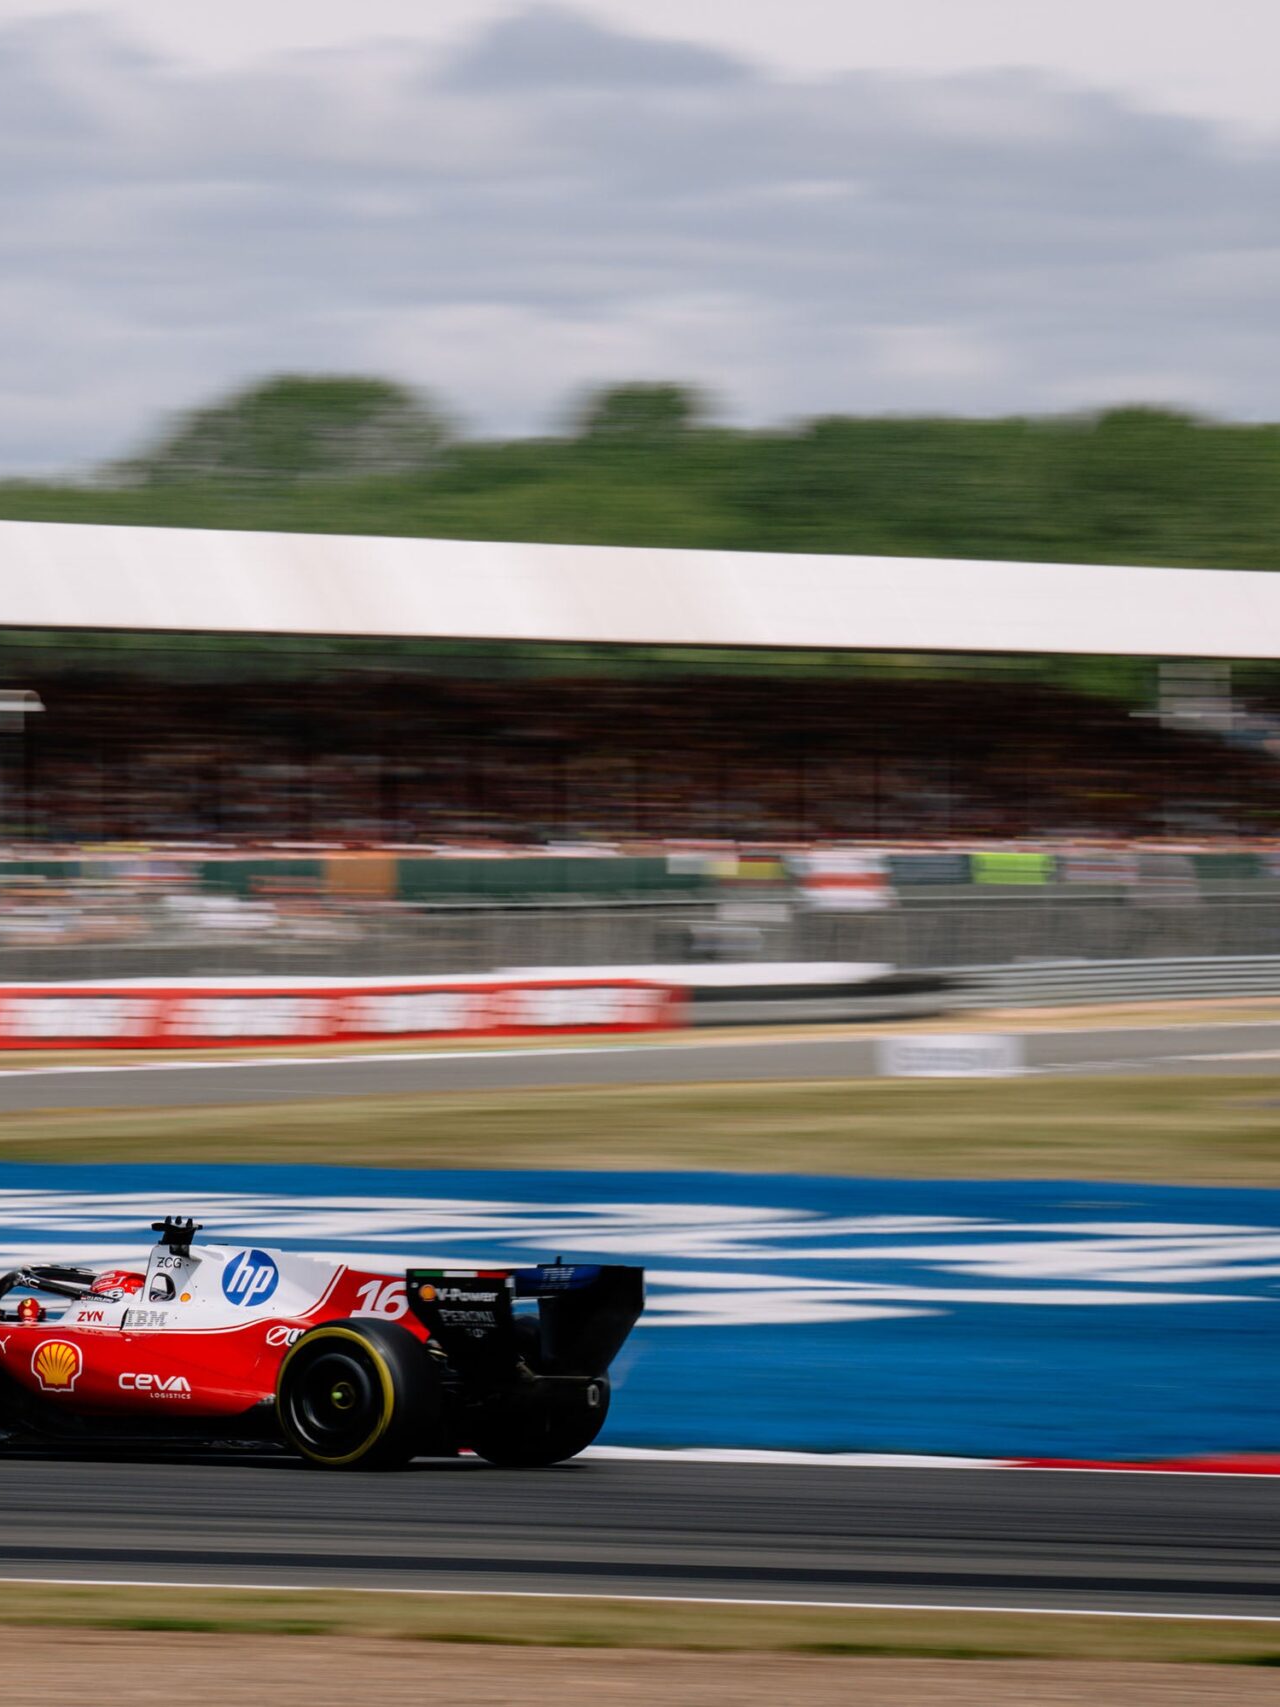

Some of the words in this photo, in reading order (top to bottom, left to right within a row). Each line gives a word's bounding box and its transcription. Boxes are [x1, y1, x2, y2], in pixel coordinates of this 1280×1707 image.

[157, 1256, 182, 1268] ZCG
[226, 1250, 275, 1306] hp
[349, 1280, 410, 1321] 16
[77, 1311, 104, 1322] ZYN
[125, 1309, 168, 1326] IBM
[150, 1392, 192, 1400] LOGISTICS
